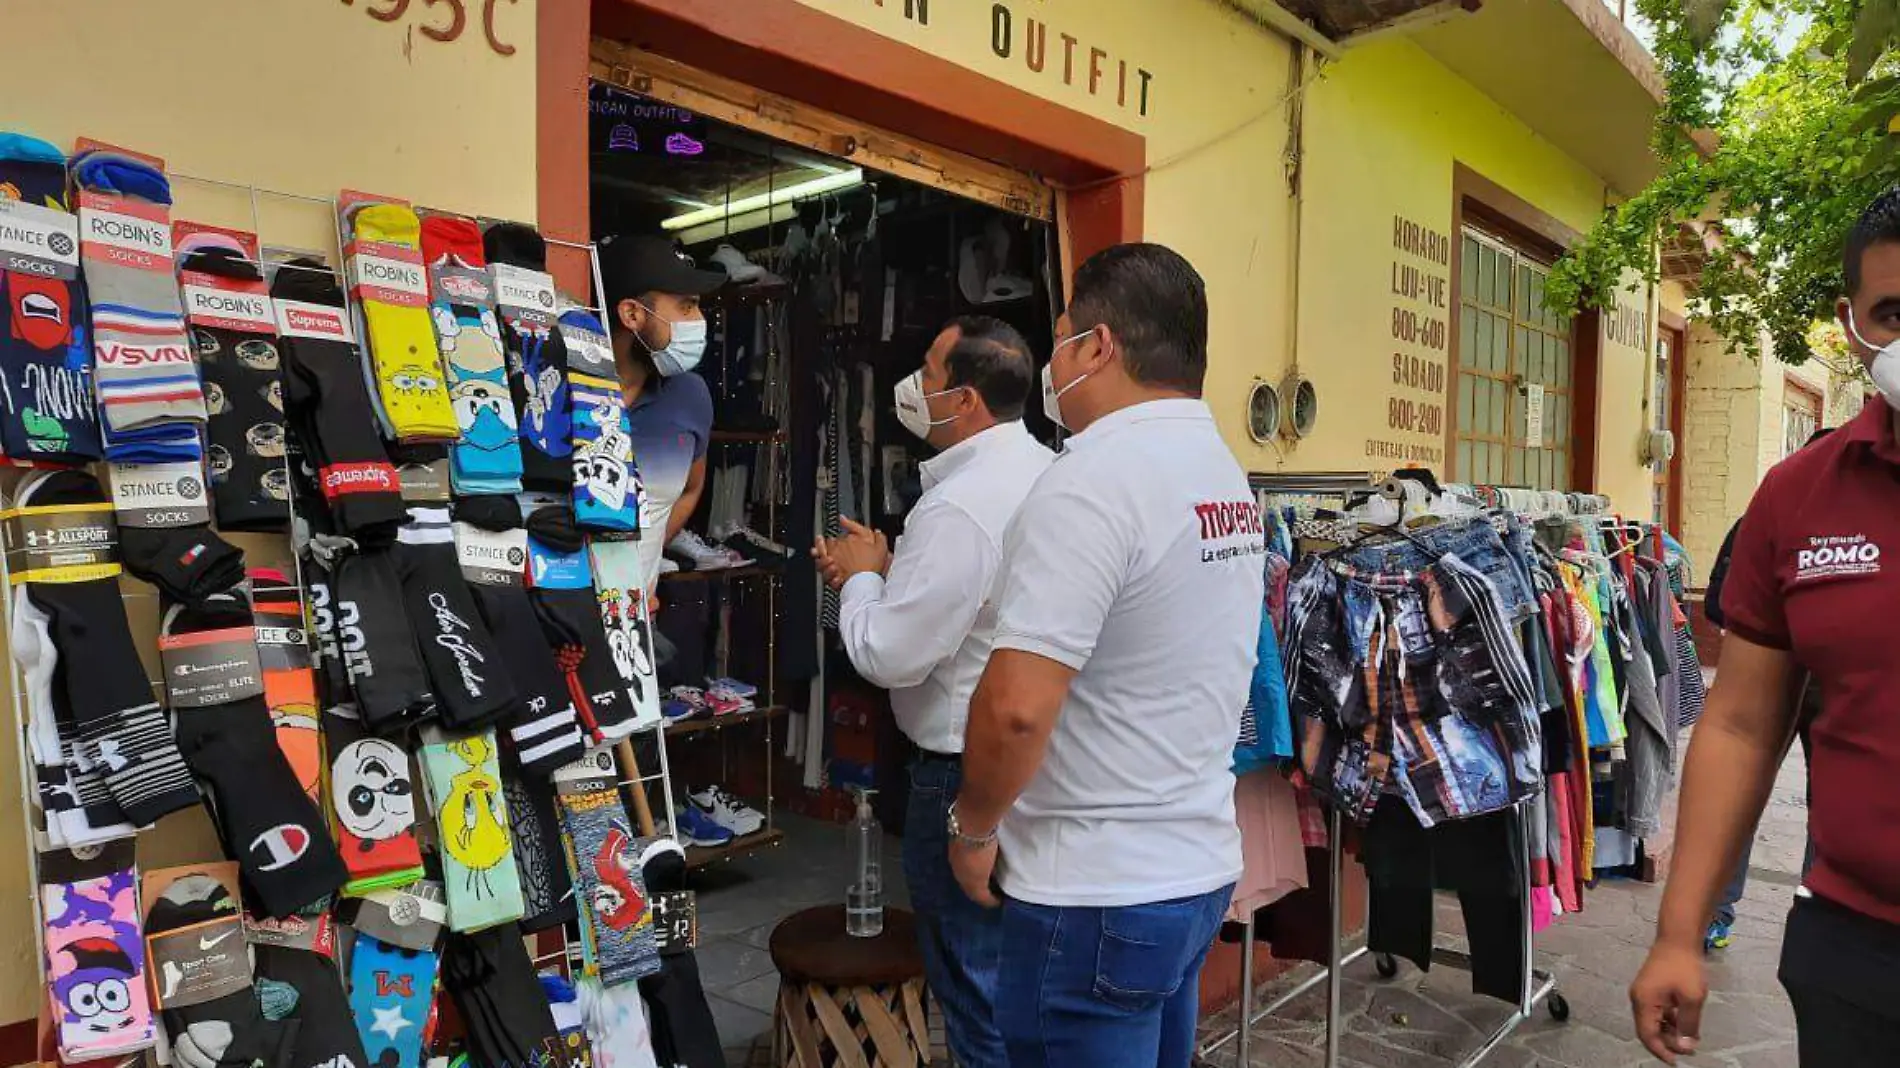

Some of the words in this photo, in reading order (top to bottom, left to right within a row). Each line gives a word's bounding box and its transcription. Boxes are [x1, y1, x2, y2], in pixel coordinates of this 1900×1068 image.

[991, 2, 1153, 117] OUTFIT
[91, 216, 164, 247] ROBIN'S
[1393, 213, 1449, 266] HORARIO
[364, 262, 419, 286] ROBIN'S
[196, 293, 264, 316] ROBIN'S
[288, 311, 341, 332] Supreme
[1393, 352, 1444, 394] SABADO
[120, 482, 176, 497] STANCE
[145, 511, 191, 525] SOCKS
[1194, 501, 1264, 540] morena
[1798, 543, 1880, 570] ROMO
